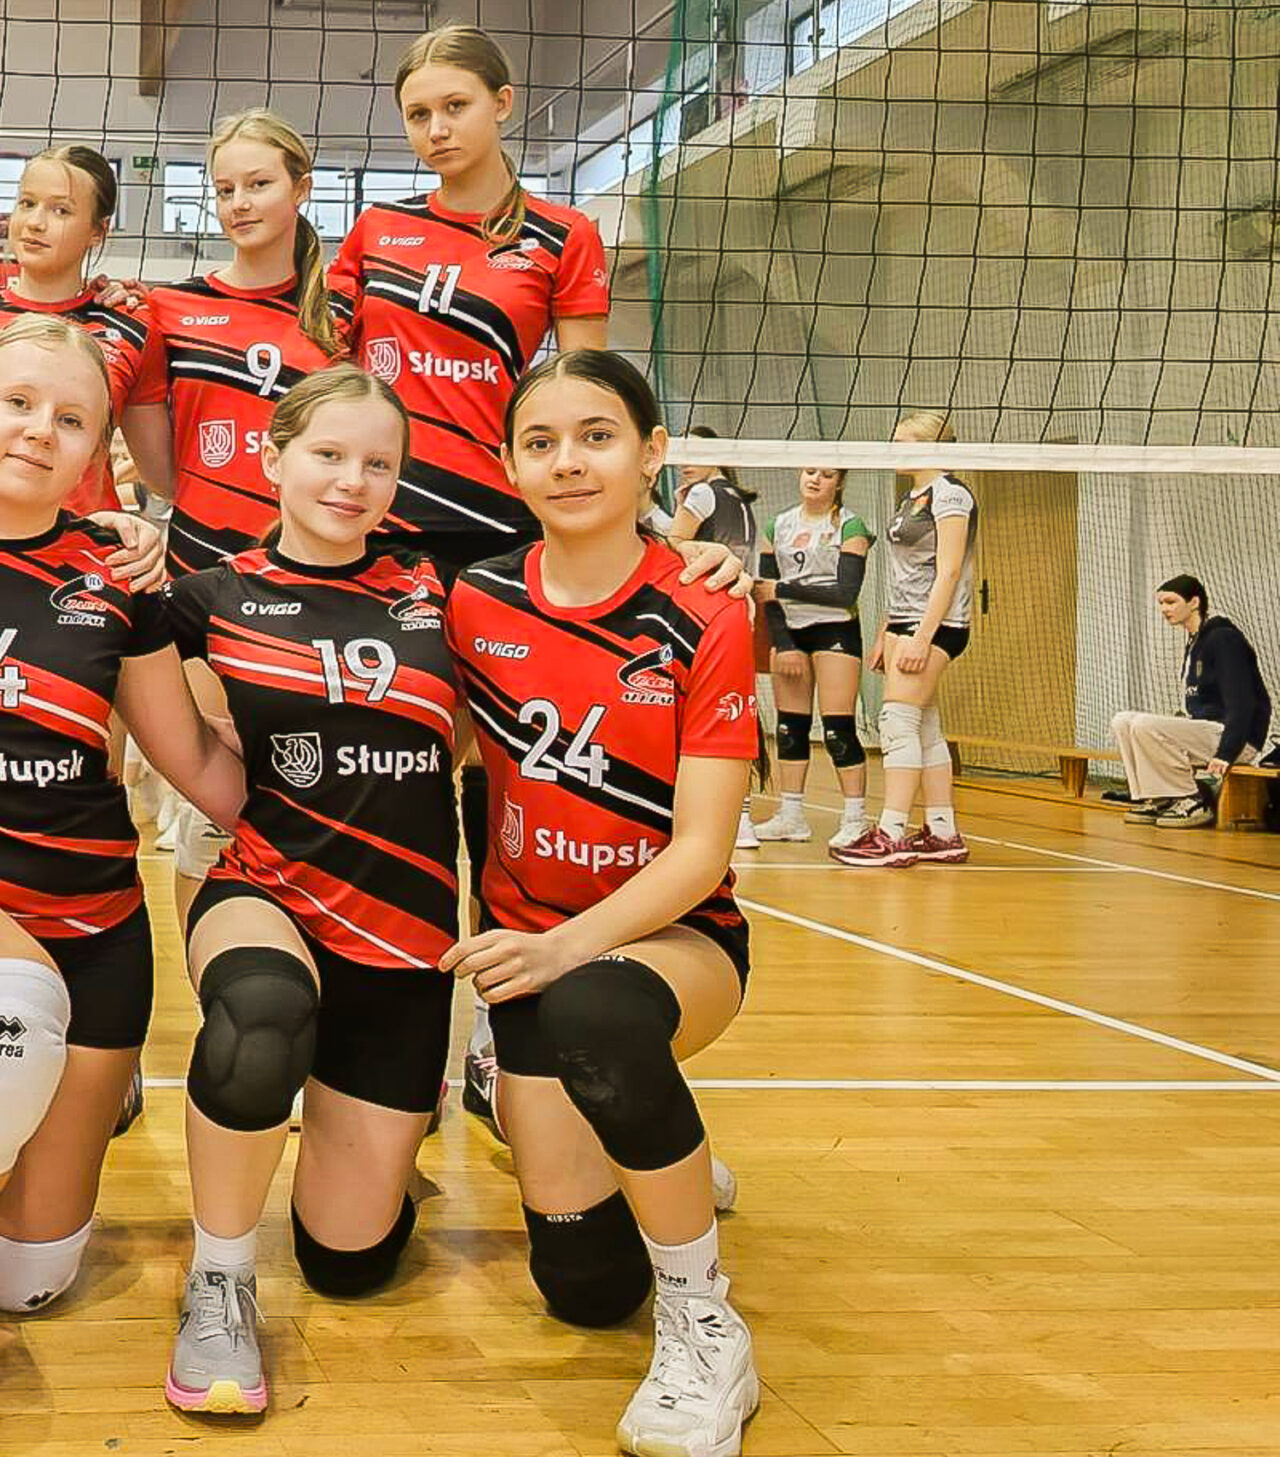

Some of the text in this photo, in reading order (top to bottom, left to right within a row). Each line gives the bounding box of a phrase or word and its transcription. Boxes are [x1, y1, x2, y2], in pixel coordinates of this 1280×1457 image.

[418, 264, 462, 314] 11
[246, 342, 282, 396] 9
[408, 350, 500, 385] Słupsk
[793, 551, 806, 573] 9
[311, 638, 397, 704] 19
[336, 743, 440, 781] Słupsk
[518, 698, 611, 788] 24
[535, 826, 661, 875] Słupsk
